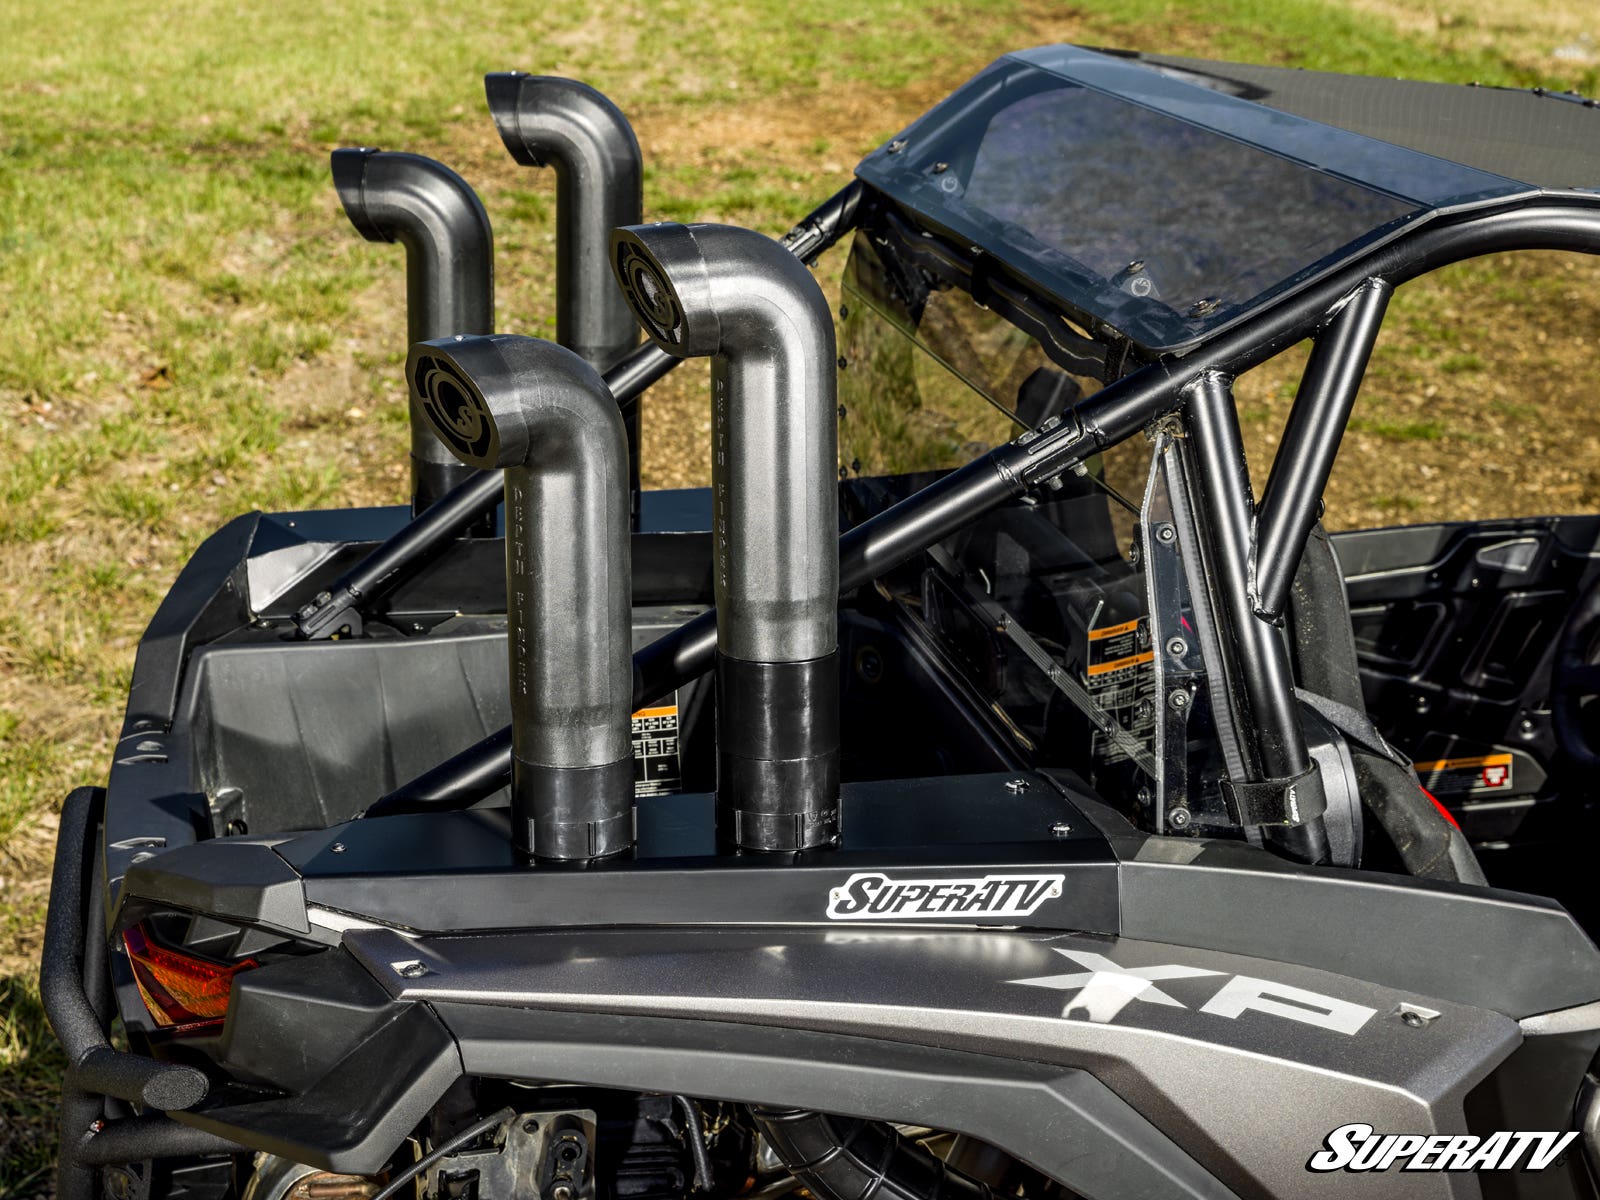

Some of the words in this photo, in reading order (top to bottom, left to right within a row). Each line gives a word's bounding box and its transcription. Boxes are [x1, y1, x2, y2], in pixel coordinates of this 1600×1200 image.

[512, 486, 525, 576] DEPTH
[834, 876, 1057, 915] SUPERATV
[1003, 946, 1379, 1036] XP
